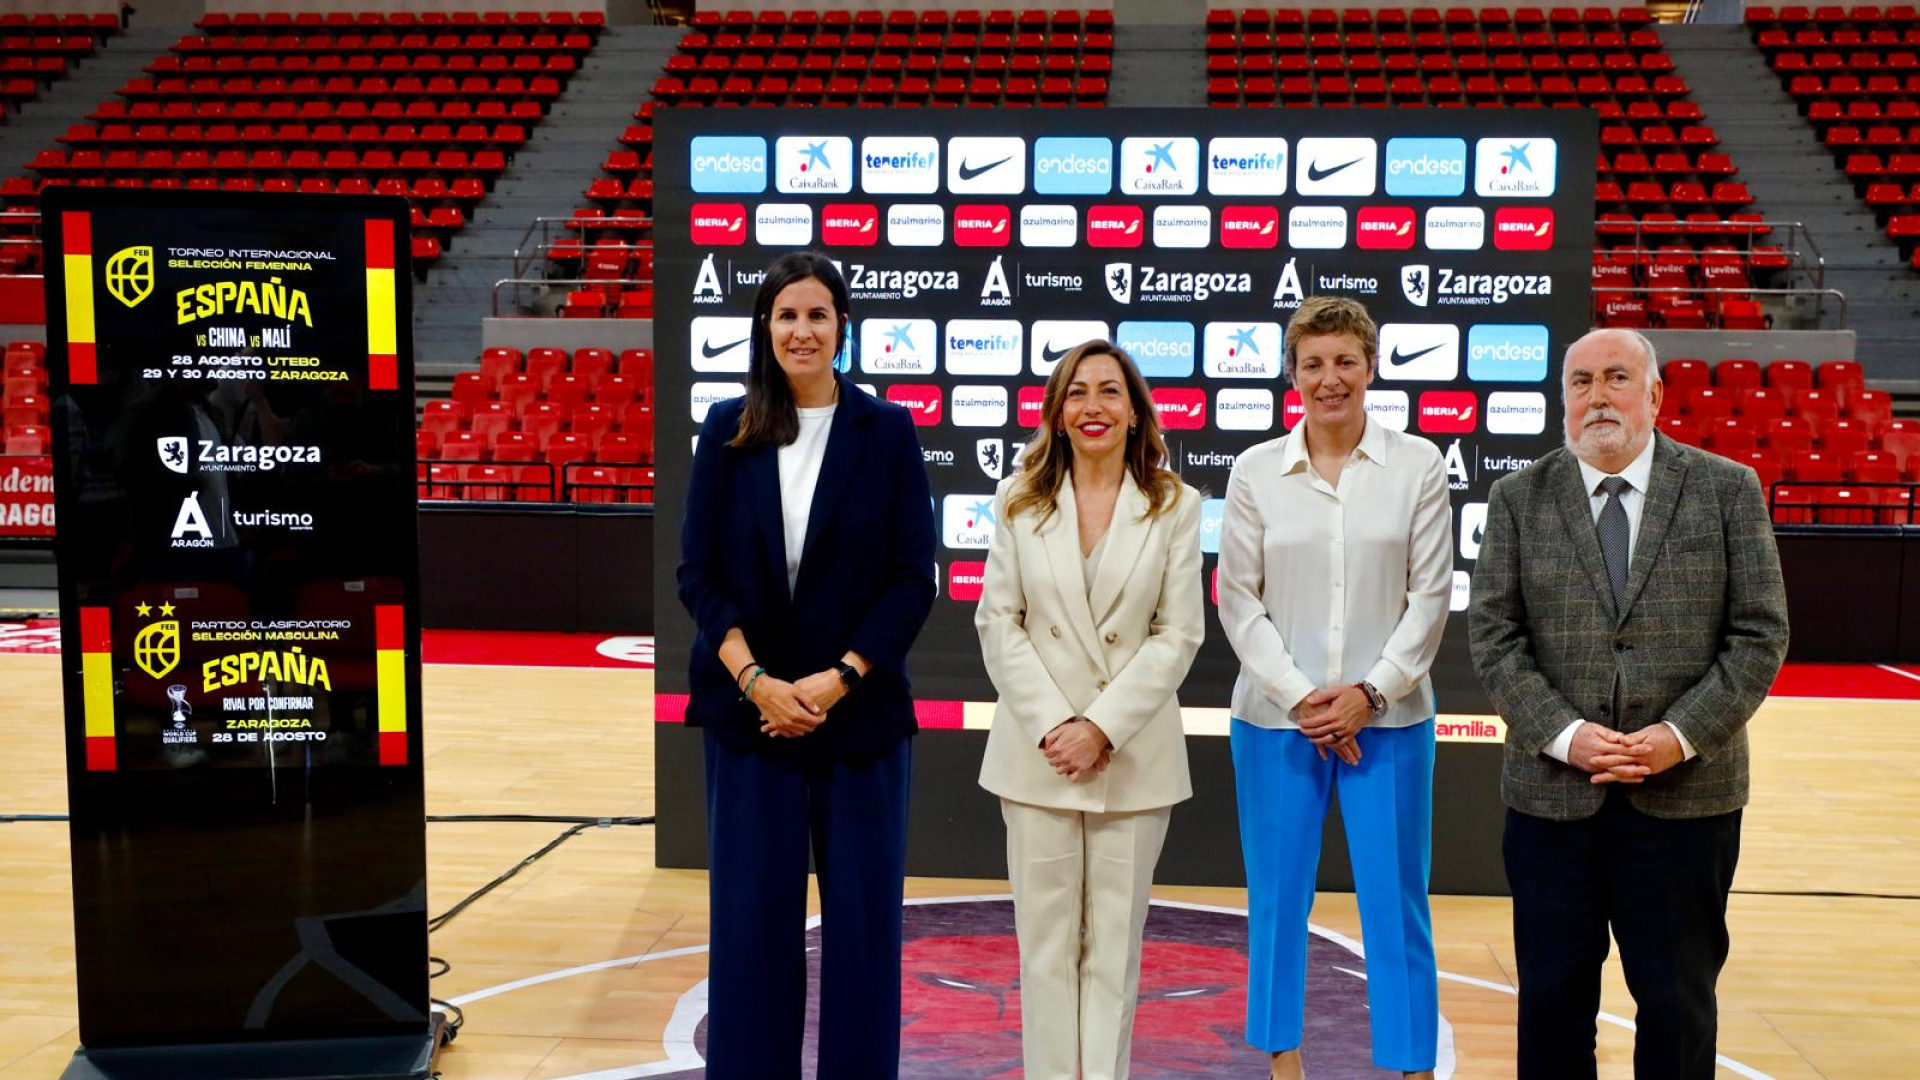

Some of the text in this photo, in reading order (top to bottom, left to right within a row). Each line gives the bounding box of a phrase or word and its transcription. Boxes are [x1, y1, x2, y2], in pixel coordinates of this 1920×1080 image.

[694, 153, 763, 173] endesa
[1037, 154, 1109, 174] endesa
[1389, 155, 1462, 175] endesa
[790, 177, 839, 189] CaixaBank
[1134, 179, 1184, 190] CaixaBank
[1489, 180, 1540, 192] CaixaBank
[694, 218, 729, 227] IBERIA
[758, 216, 810, 225] azulmarino
[826, 219, 860, 228] IBERIA
[890, 216, 941, 225] azulmarino
[957, 220, 993, 229] IBERIA
[1022, 217, 1075, 226] azulmarino
[1091, 220, 1126, 229] IBERIA
[1156, 217, 1208, 227] azulmarino
[1224, 221, 1260, 230] IBERIA
[1291, 218, 1344, 228] azulmarino
[1361, 221, 1397, 231] IBERIA
[1428, 219, 1482, 229] azulmarino
[1498, 222, 1535, 231] IBERIA
[134, 249, 150, 257] FEB
[168, 247, 336, 260] TORNEO INTERNACIONAL
[168, 258, 313, 271] SELECCIÓN FEMENINA
[850, 264, 959, 298] Zaragoza
[1025, 272, 1082, 288] turismo
[1140, 266, 1251, 300] Zaragoza
[1319, 274, 1378, 289] turismo
[1437, 268, 1552, 303] Zaragoza
[176, 276, 314, 327] ESPAÑA
[693, 294, 723, 303] ARAGÓN
[851, 292, 901, 300] AYUNTAMIENTO
[980, 296, 1011, 306] ARAGÓN
[1140, 294, 1191, 302] AYUNTAMIENTO
[1437, 296, 1491, 305] AYUNTAMIENTO
[209, 327, 246, 348] CHINA
[262, 324, 291, 348] MALÍ
[1121, 338, 1191, 357] endesa
[1471, 340, 1544, 361] endesa
[172, 355, 320, 367] 28 AGOSTO UTEBO
[874, 358, 922, 370] CaixaBank
[1217, 362, 1267, 373] CaixaBank
[143, 369, 349, 381] 29 Y 30 AGOSTO ZARAGOZA
[954, 397, 1005, 407] azulmarino
[1219, 402, 1271, 410] azulmarino
[1364, 403, 1406, 412] ulmarino
[1423, 407, 1458, 416] IBERIA
[1489, 404, 1543, 414] azulmarino
[198, 440, 322, 470] Zaragoza
[1188, 451, 1236, 466] turism
[199, 464, 257, 472] AYUNTAMIENTO
[1484, 456, 1537, 470] turism
[0, 466, 55, 493] dem
[1448, 481, 1469, 490] AGÓN
[233, 509, 313, 526] turismo
[171, 538, 214, 548] ARAGÓN
[956, 533, 989, 545] CaixaB
[161, 623, 176, 631] FEB
[192, 620, 351, 630] PARTIDO CLASIFICATORIO
[192, 630, 339, 641] SELECCIÓN MASCULINA
[202, 646, 332, 693] ESPAÑA
[223, 697, 313, 711] RIVAL POR CONFIRMAR
[226, 718, 312, 730] ZARAGOZA
[1436, 721, 1497, 738] amilia
[212, 731, 327, 743] 28 DE AGOSTO
